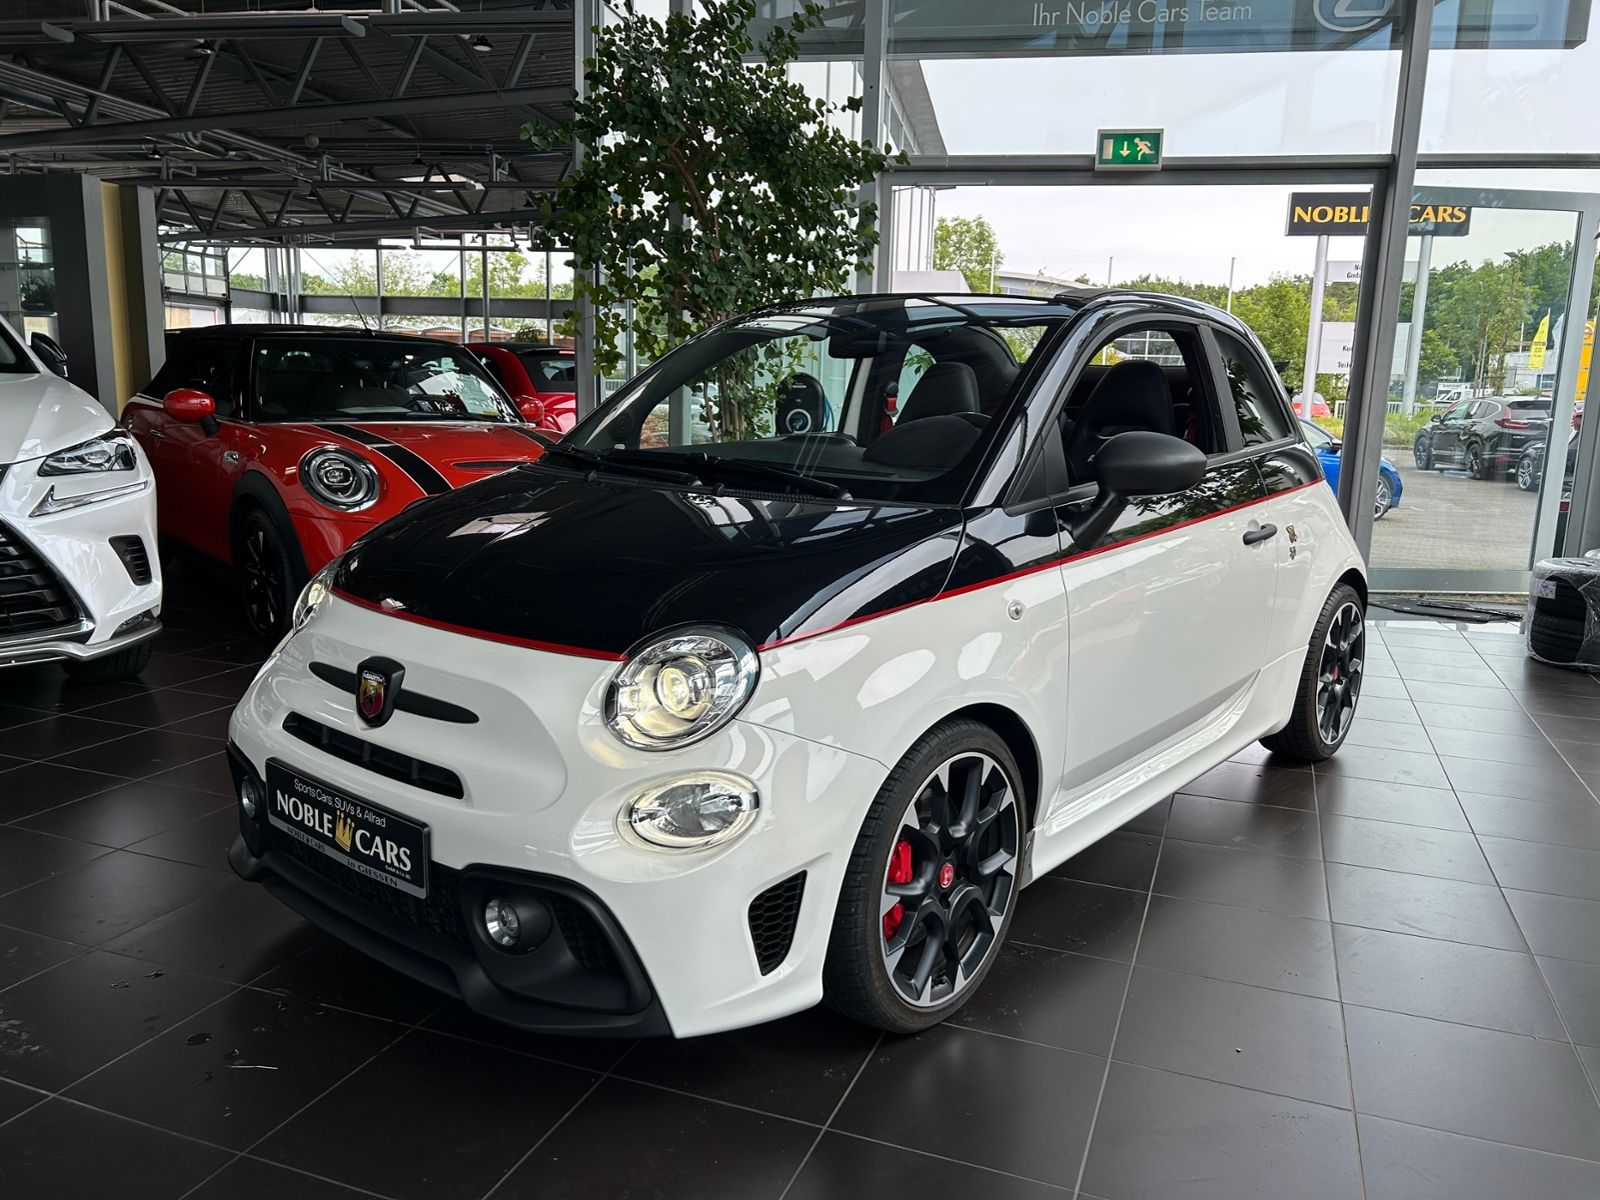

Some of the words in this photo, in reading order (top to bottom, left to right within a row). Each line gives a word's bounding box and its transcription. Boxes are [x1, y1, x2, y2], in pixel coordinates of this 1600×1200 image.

[1032, 3, 1060, 26] Ihr
[1066, 1, 1131, 25] Noble
[1137, 0, 1189, 23] Cars
[1198, 0, 1252, 21] Team
[1409, 205, 1467, 223] CARS
[294, 778, 316, 798] Sports
[316, 789, 334, 808] Cars,
[334, 797, 355, 815] SUVs
[356, 807, 362, 818] &
[363, 810, 386, 828] Allrad
[276, 789, 333, 838] NOBLE
[355, 829, 412, 872] CARS
[347, 858, 356, 868] in
[359, 863, 399, 887] GIESSEN
